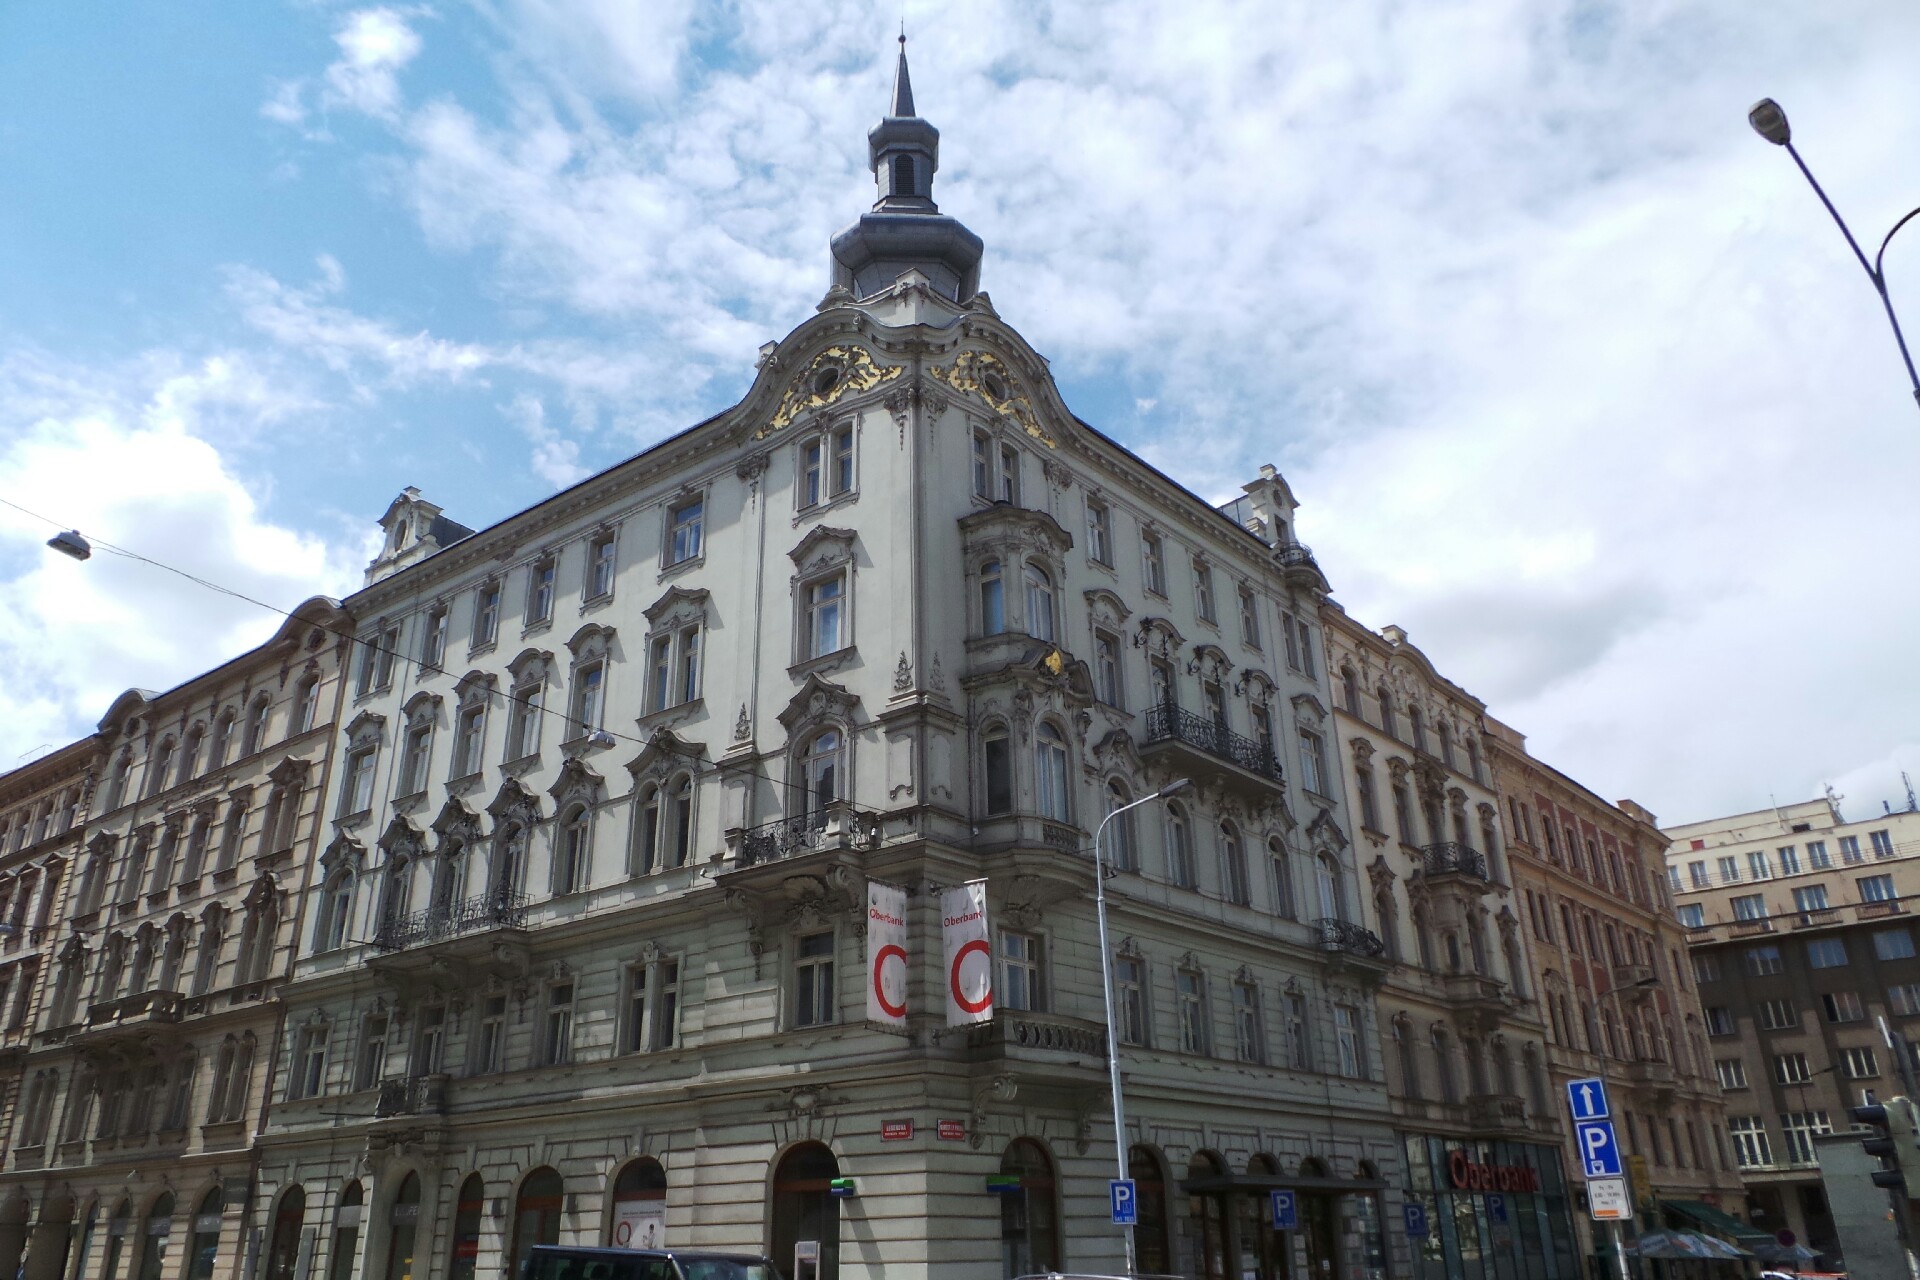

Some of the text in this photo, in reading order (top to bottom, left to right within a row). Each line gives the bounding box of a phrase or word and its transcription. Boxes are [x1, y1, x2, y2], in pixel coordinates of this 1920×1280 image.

[869, 908, 904, 927] Oberbank
[944, 910, 983, 928] Oberbank
[1585, 1128, 1607, 1160] P
[1115, 1186, 1130, 1211] P
[1276, 1195, 1290, 1217] P
[1407, 1208, 1420, 1228] P
